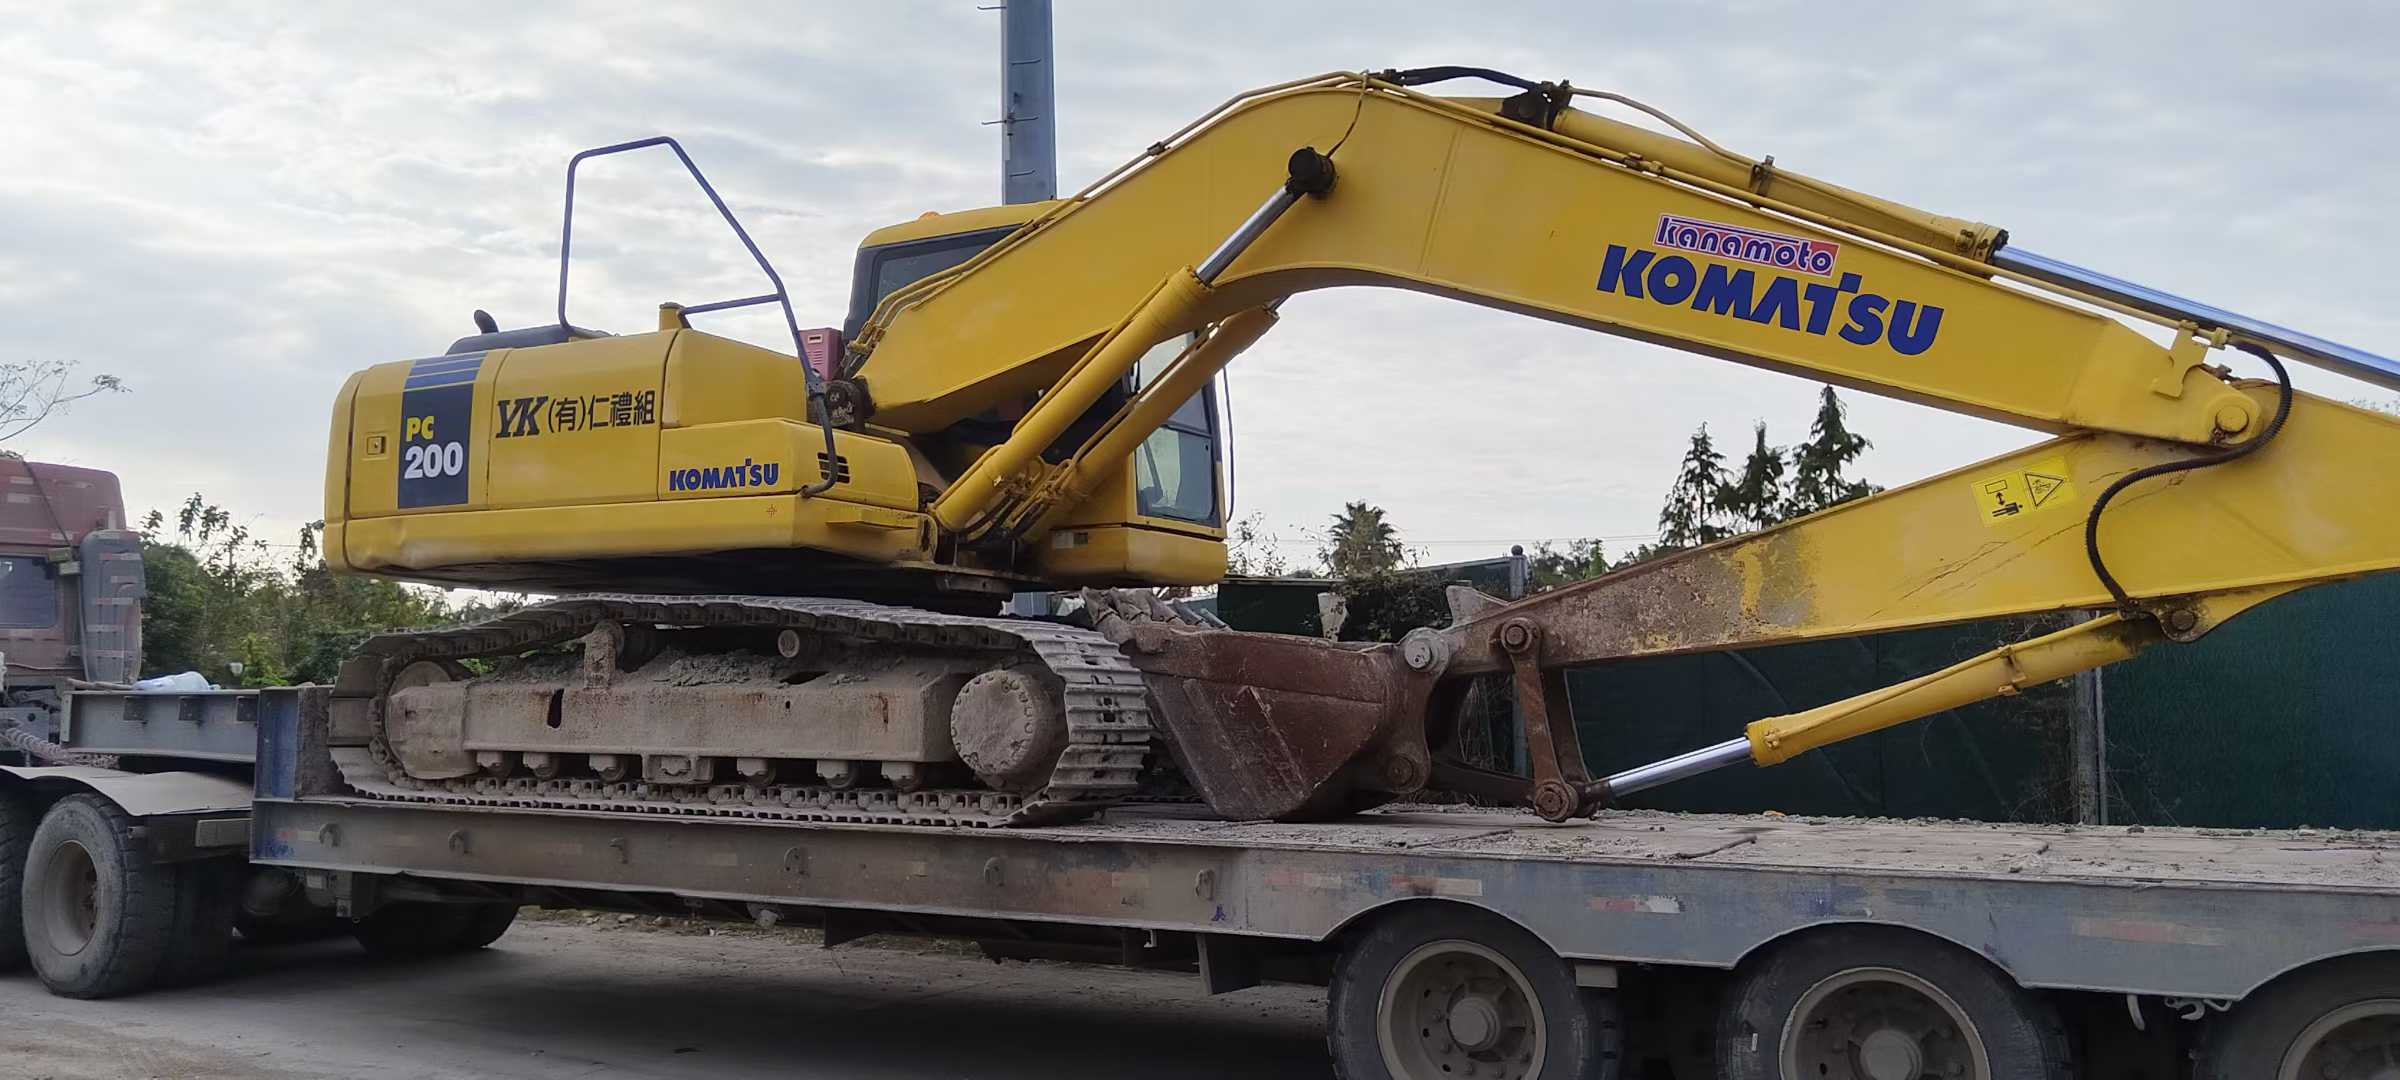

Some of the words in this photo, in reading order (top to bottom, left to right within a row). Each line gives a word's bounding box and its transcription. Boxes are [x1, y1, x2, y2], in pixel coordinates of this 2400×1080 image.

[1655, 216, 1835, 275] kanamoto
[1597, 244, 1944, 355] KOMATSU
[406, 415, 434, 441] PC
[496, 396, 548, 438] YK
[404, 441, 463, 479] 200
[669, 458, 779, 491] KOMATSU
